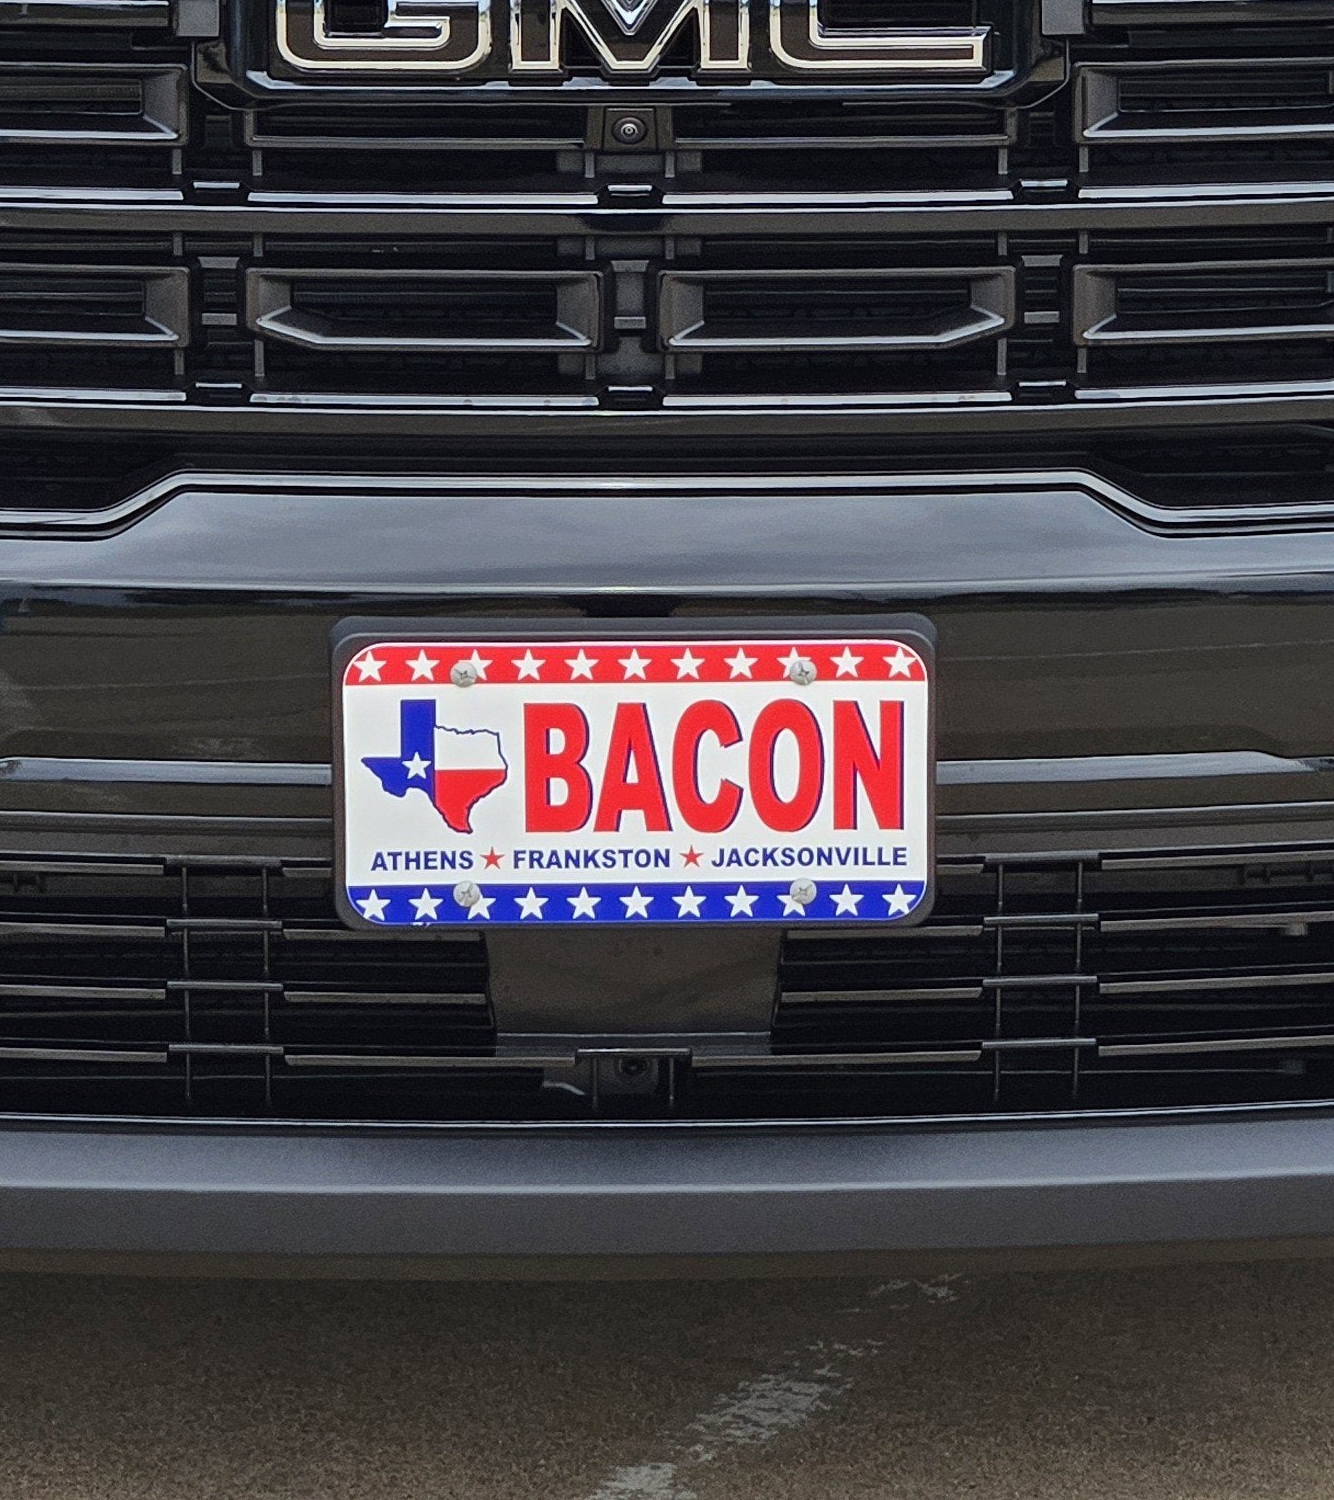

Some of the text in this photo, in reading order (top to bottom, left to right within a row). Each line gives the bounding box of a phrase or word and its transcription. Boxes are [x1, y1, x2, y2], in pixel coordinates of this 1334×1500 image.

[523, 699, 905, 834] BACON
[370, 845, 909, 872] ATHENS FRANKSTON JACKSONVILLE
